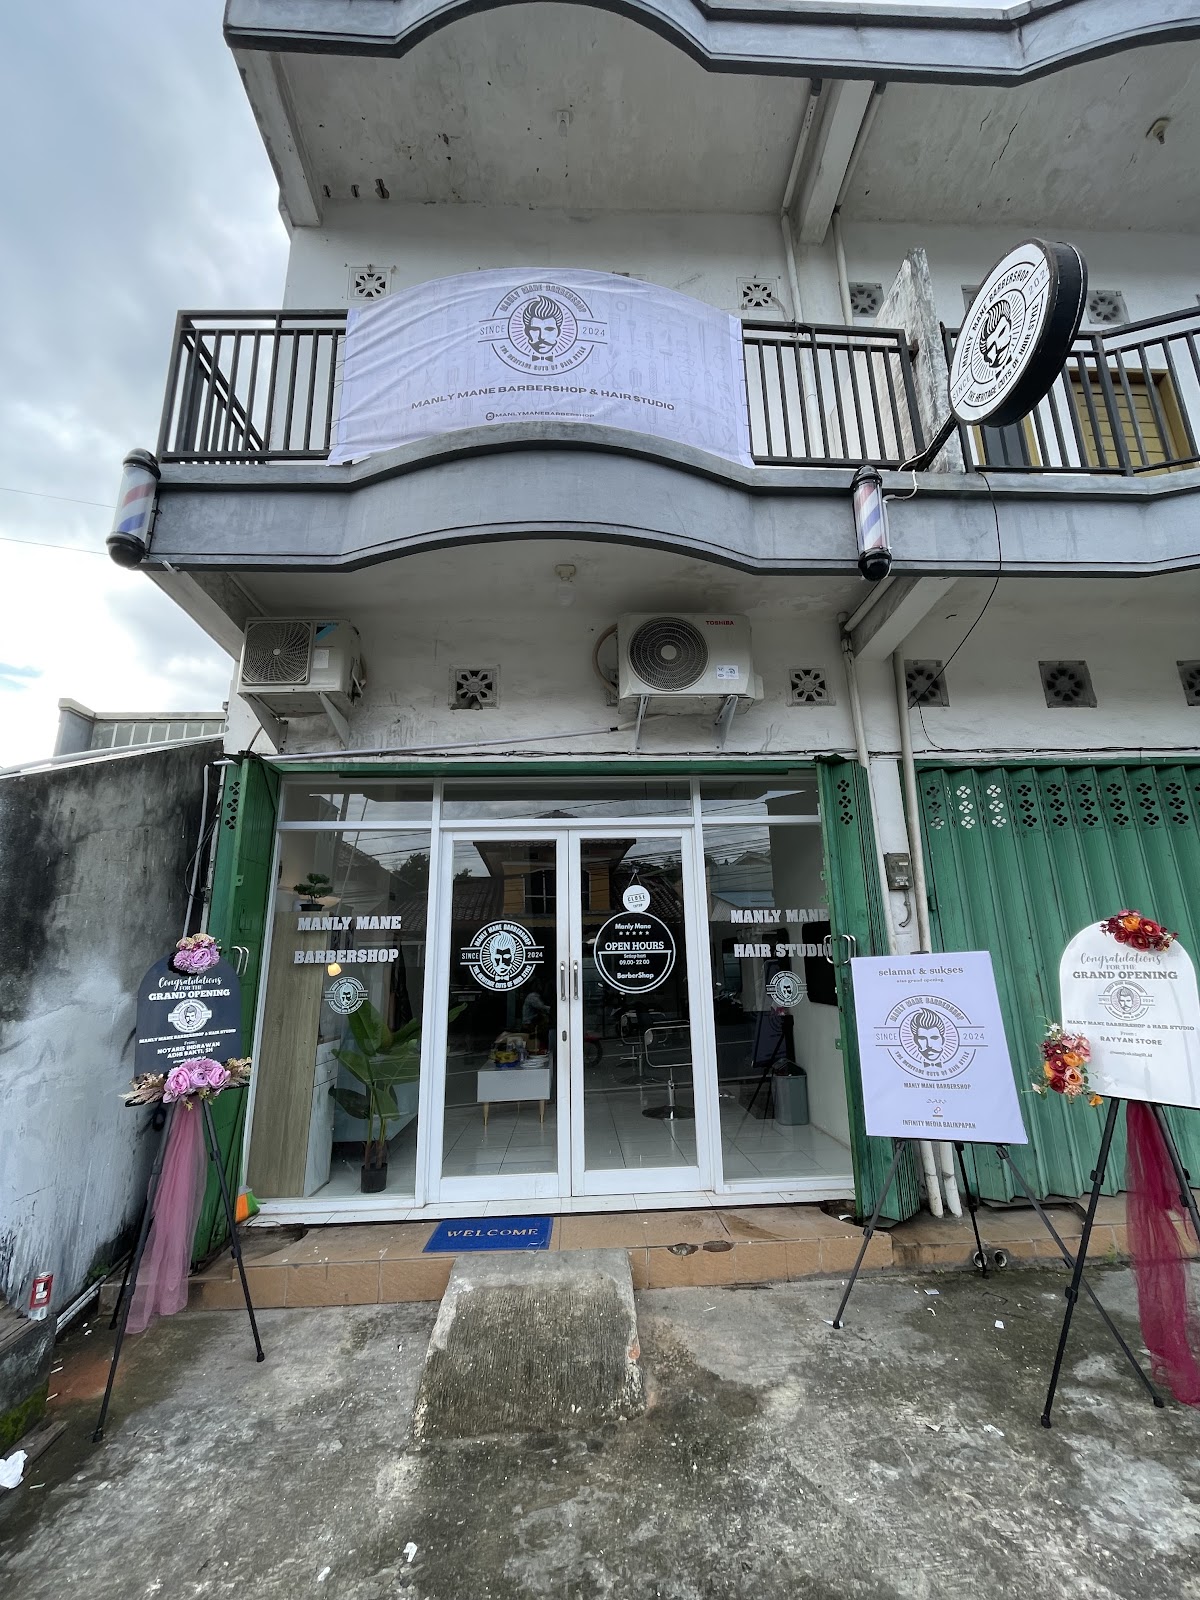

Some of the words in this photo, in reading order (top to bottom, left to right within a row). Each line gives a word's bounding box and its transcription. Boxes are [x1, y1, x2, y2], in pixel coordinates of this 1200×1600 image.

[962, 336, 974, 369] MANLY
[972, 304, 988, 331] MANE
[988, 270, 1030, 303] BARBERSHOP
[480, 325, 506, 336] SINCE
[582, 326, 606, 336] 2024
[974, 384, 997, 403] HERITAGE
[998, 370, 1012, 389] CUTS
[1012, 357, 1019, 369] OF
[1019, 334, 1032, 356] HAIR
[1028, 304, 1040, 330] STYLE
[952, 375, 971, 402] SINCE
[411, 394, 455, 410] MANLY
[457, 387, 496, 399] MANE
[498, 384, 587, 394] BARBERSHOP
[601, 390, 632, 401] HAIR
[632, 396, 675, 411] STUDIO
[297, 916, 352, 931] MANLY
[356, 916, 402, 930] MANE
[730, 909, 781, 924] MANLY
[785, 909, 830, 922] MANE
[605, 942, 630, 950] OPEN
[632, 941, 664, 950] HOURS
[734, 944, 771, 958] HAIR
[294, 948, 399, 964] BARBERSHOP
[1080, 952, 1161, 969] Congratulations
[878, 968, 916, 976] selamat
[930, 966, 964, 975] sukses
[1118, 971, 1178, 980] OPENING
[158, 976, 222, 991] Congratulations
[148, 991, 186, 1001] GRAND
[188, 989, 230, 998] OPENING
[157, 1046, 185, 1054] NOTARIS
[186, 1042, 220, 1050] INDRAWAN
[448, 1228, 538, 1237] WELCOME
